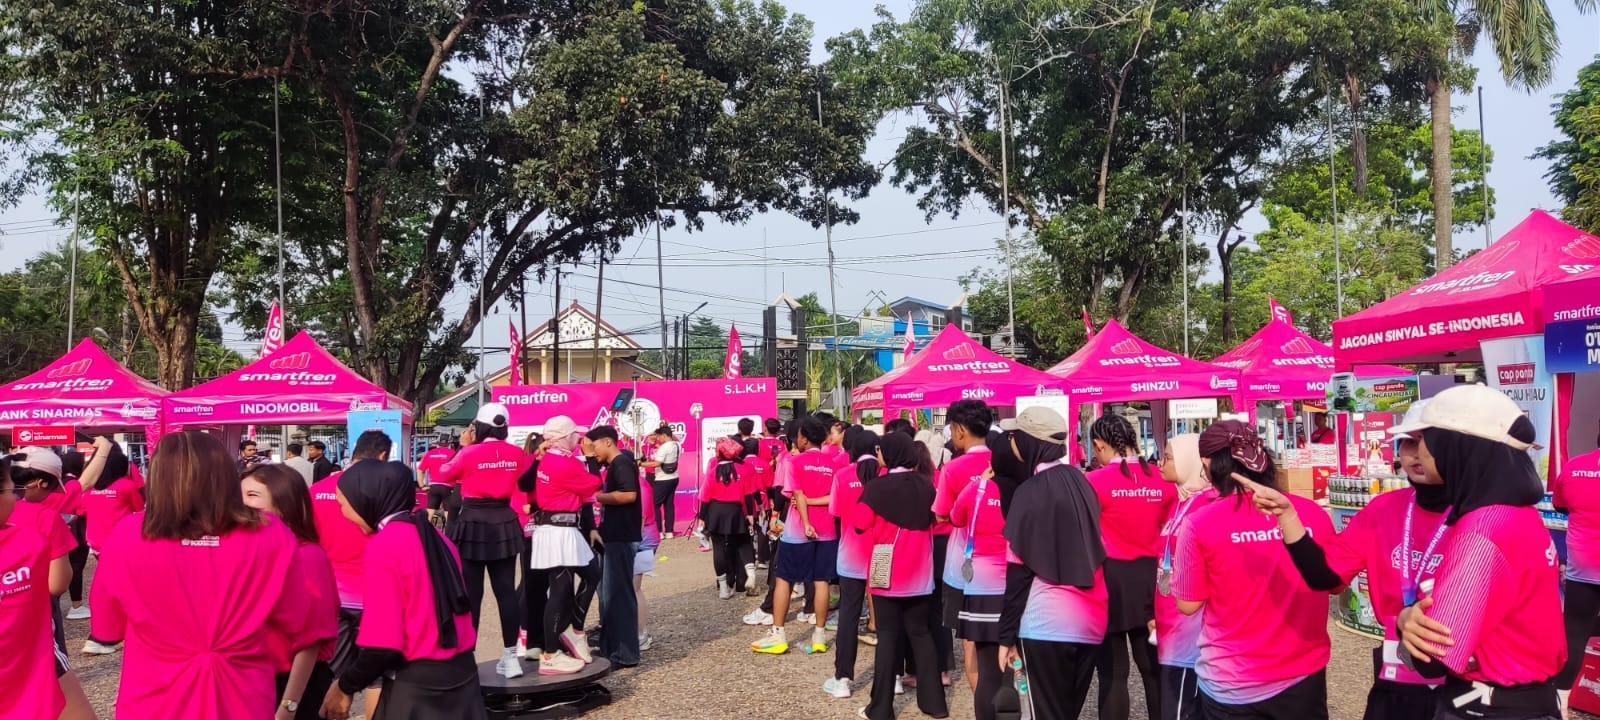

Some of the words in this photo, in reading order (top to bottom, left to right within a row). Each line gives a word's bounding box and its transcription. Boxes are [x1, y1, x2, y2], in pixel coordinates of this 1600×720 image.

[1409, 271, 1515, 297] smartfren
[1340, 332, 1383, 351] JAGOAN
[1385, 325, 1426, 342] SINYAL
[1428, 311, 1525, 335] SE-INDONESIA
[928, 361, 1009, 372] smartfren
[1099, 356, 1179, 366] smartfren
[238, 372, 337, 381] smartfren
[12, 378, 114, 391] smartfren
[724, 384, 766, 394] S.L.K.H
[1131, 381, 1179, 392] SHINZU'I
[498, 391, 568, 405] smartfren
[32, 407, 103, 418] SINARMAS
[241, 403, 321, 414] INDOMOBIL
[477, 460, 517, 470] smartfren
[1111, 487, 1163, 498] smartfren
